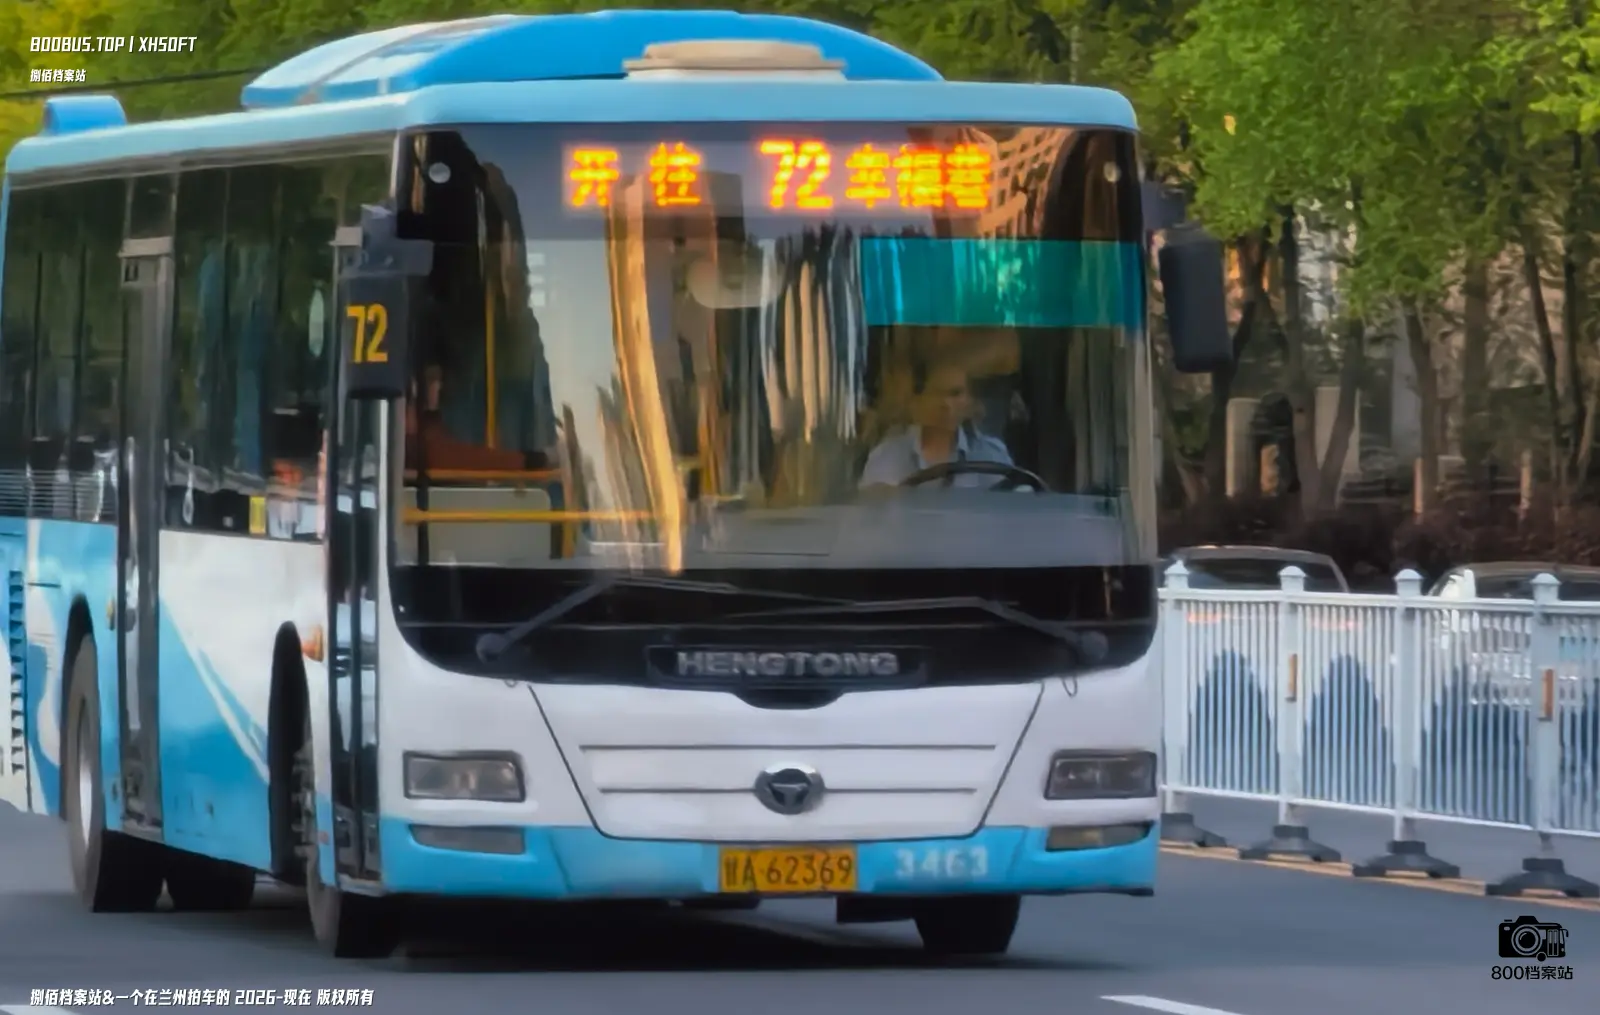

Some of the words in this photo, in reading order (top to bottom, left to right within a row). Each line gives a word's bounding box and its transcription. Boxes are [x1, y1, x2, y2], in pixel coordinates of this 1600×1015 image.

[760, 139, 833, 209] 72
[347, 304, 389, 363] 72
[677, 651, 899, 677] HENGTONG
[896, 847, 988, 880] 3463
